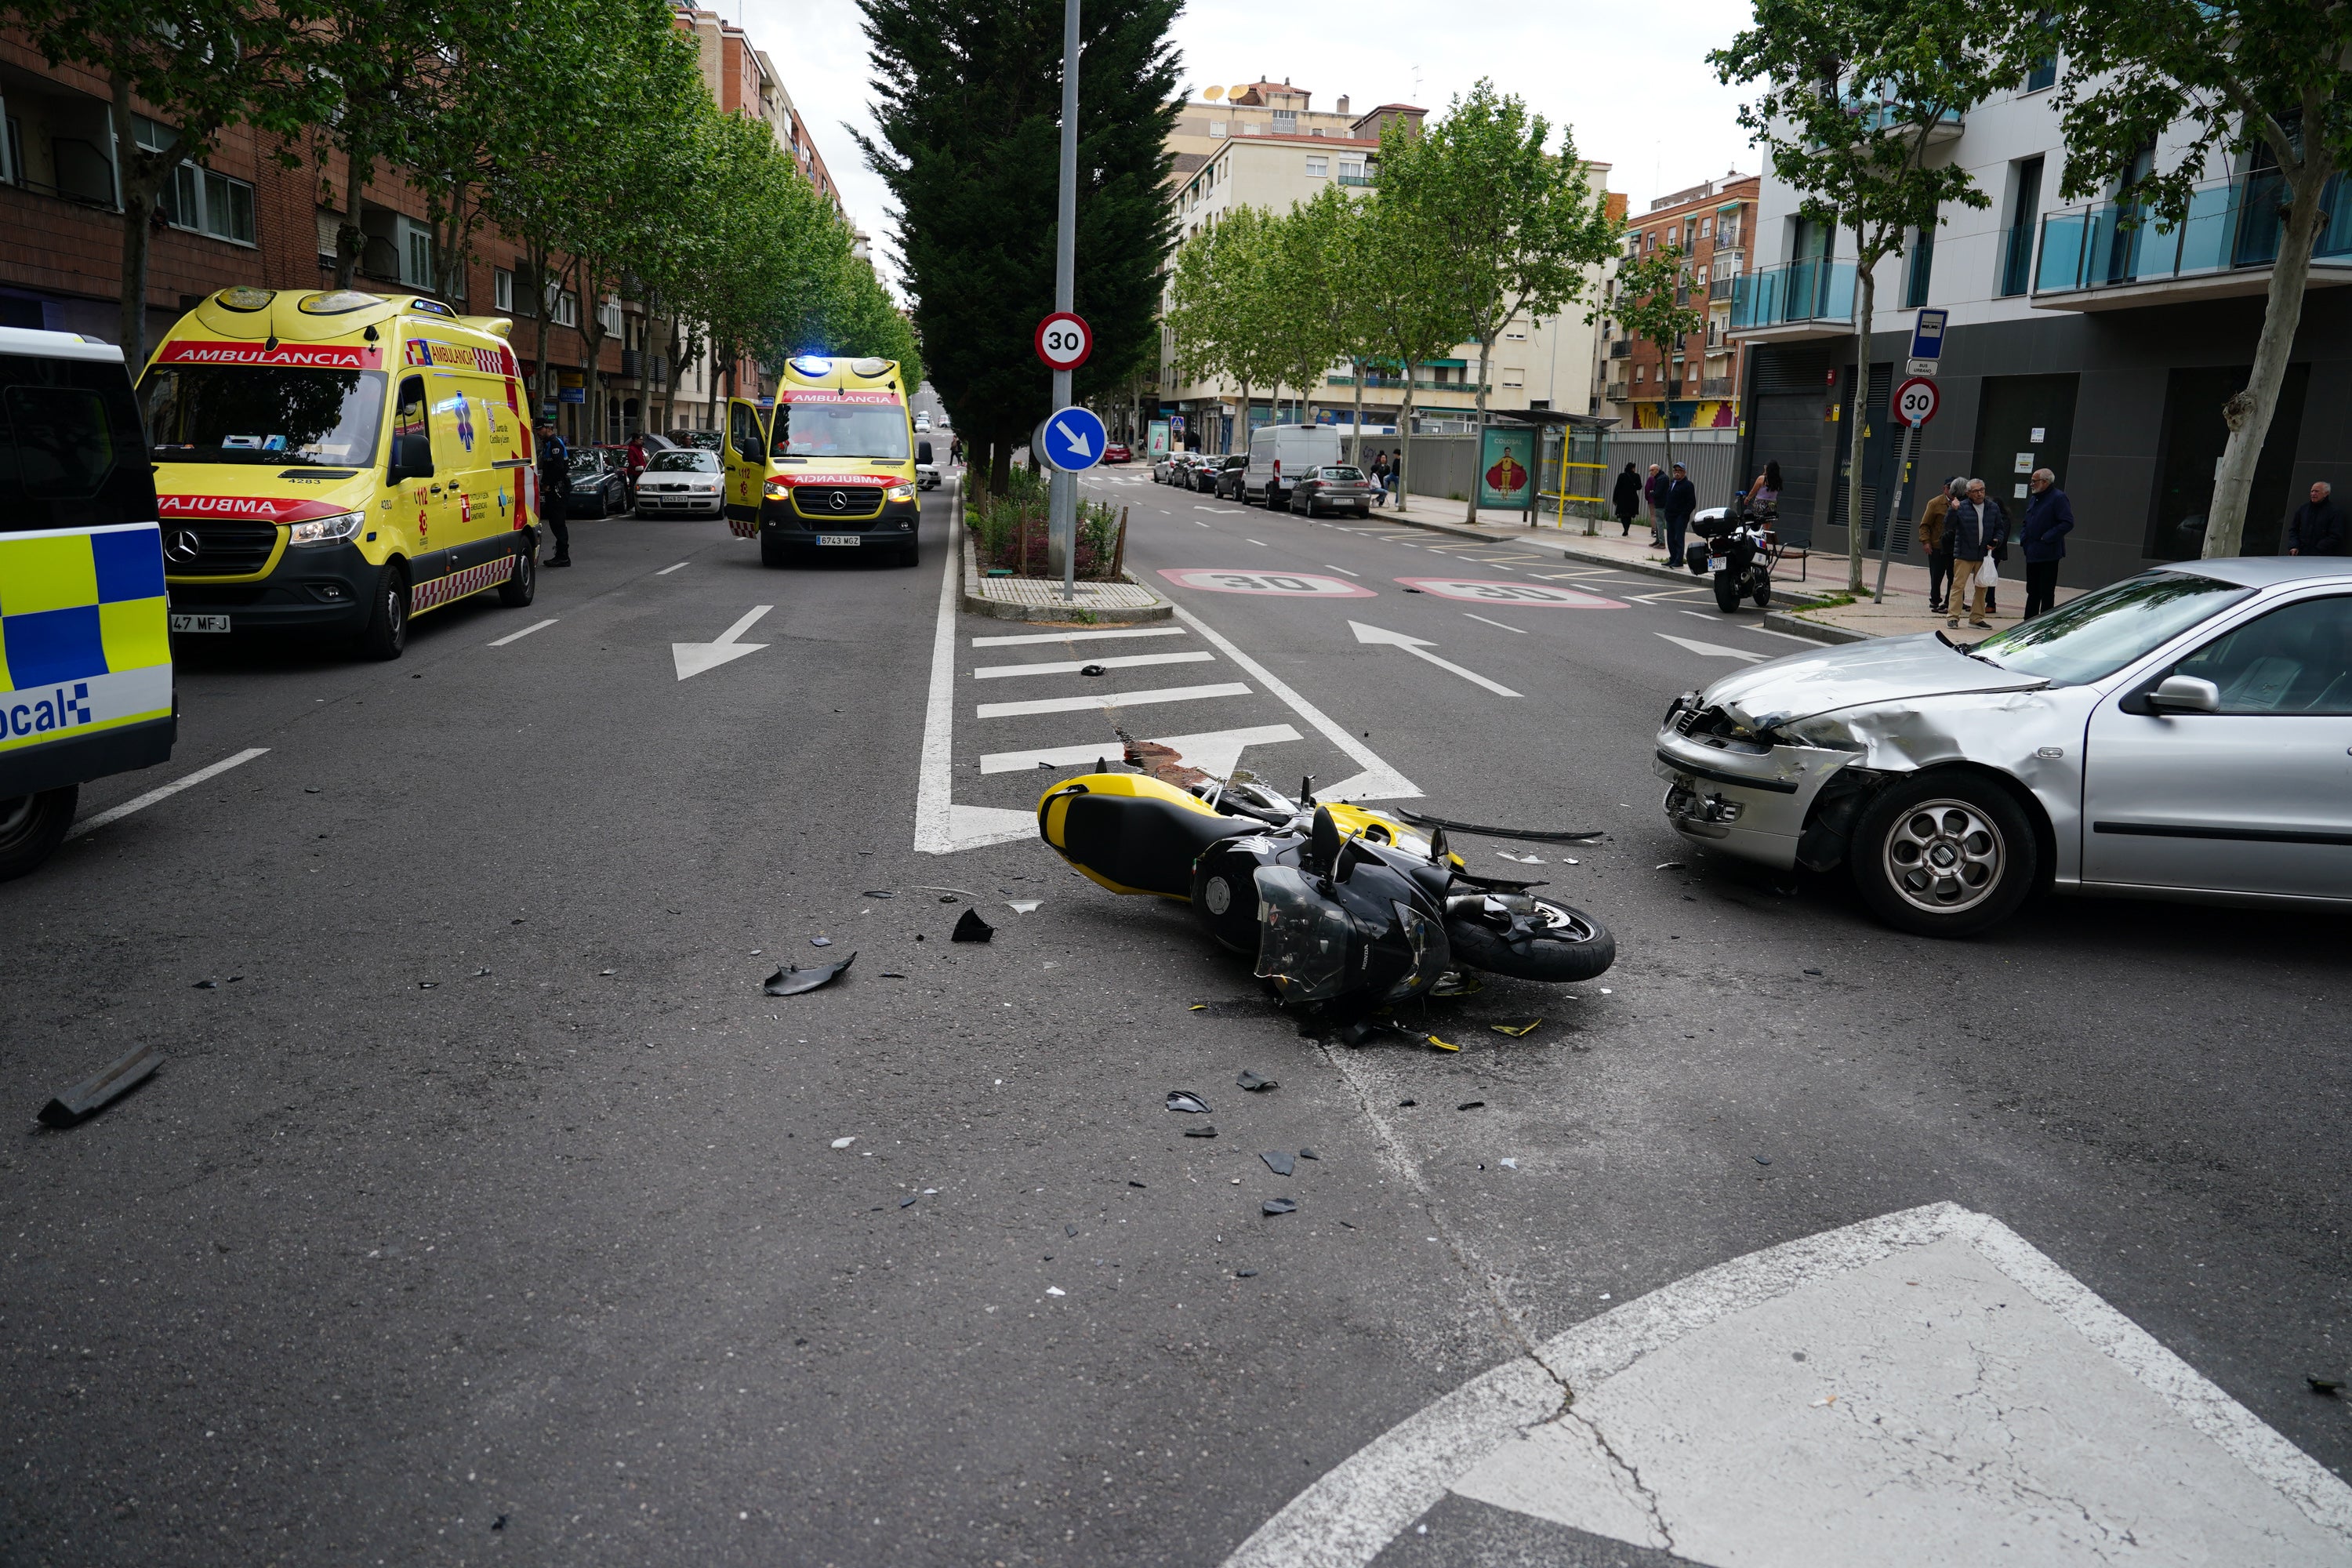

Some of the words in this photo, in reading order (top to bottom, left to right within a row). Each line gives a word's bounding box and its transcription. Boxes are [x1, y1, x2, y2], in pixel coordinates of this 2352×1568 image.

[1048, 332, 1079, 350] 30
[176, 350, 361, 366] AMBULANCIA
[432, 346, 476, 365] AMBULANCIA
[793, 394, 891, 404] AMBULANCIA
[1905, 394, 1929, 411] 30
[417, 487, 428, 506] 112
[822, 536, 841, 545] 6743
[844, 536, 858, 545] MGZ
[1210, 575, 1319, 591] 30
[1450, 583, 1568, 601] 30
[198, 616, 227, 630] MFJ
